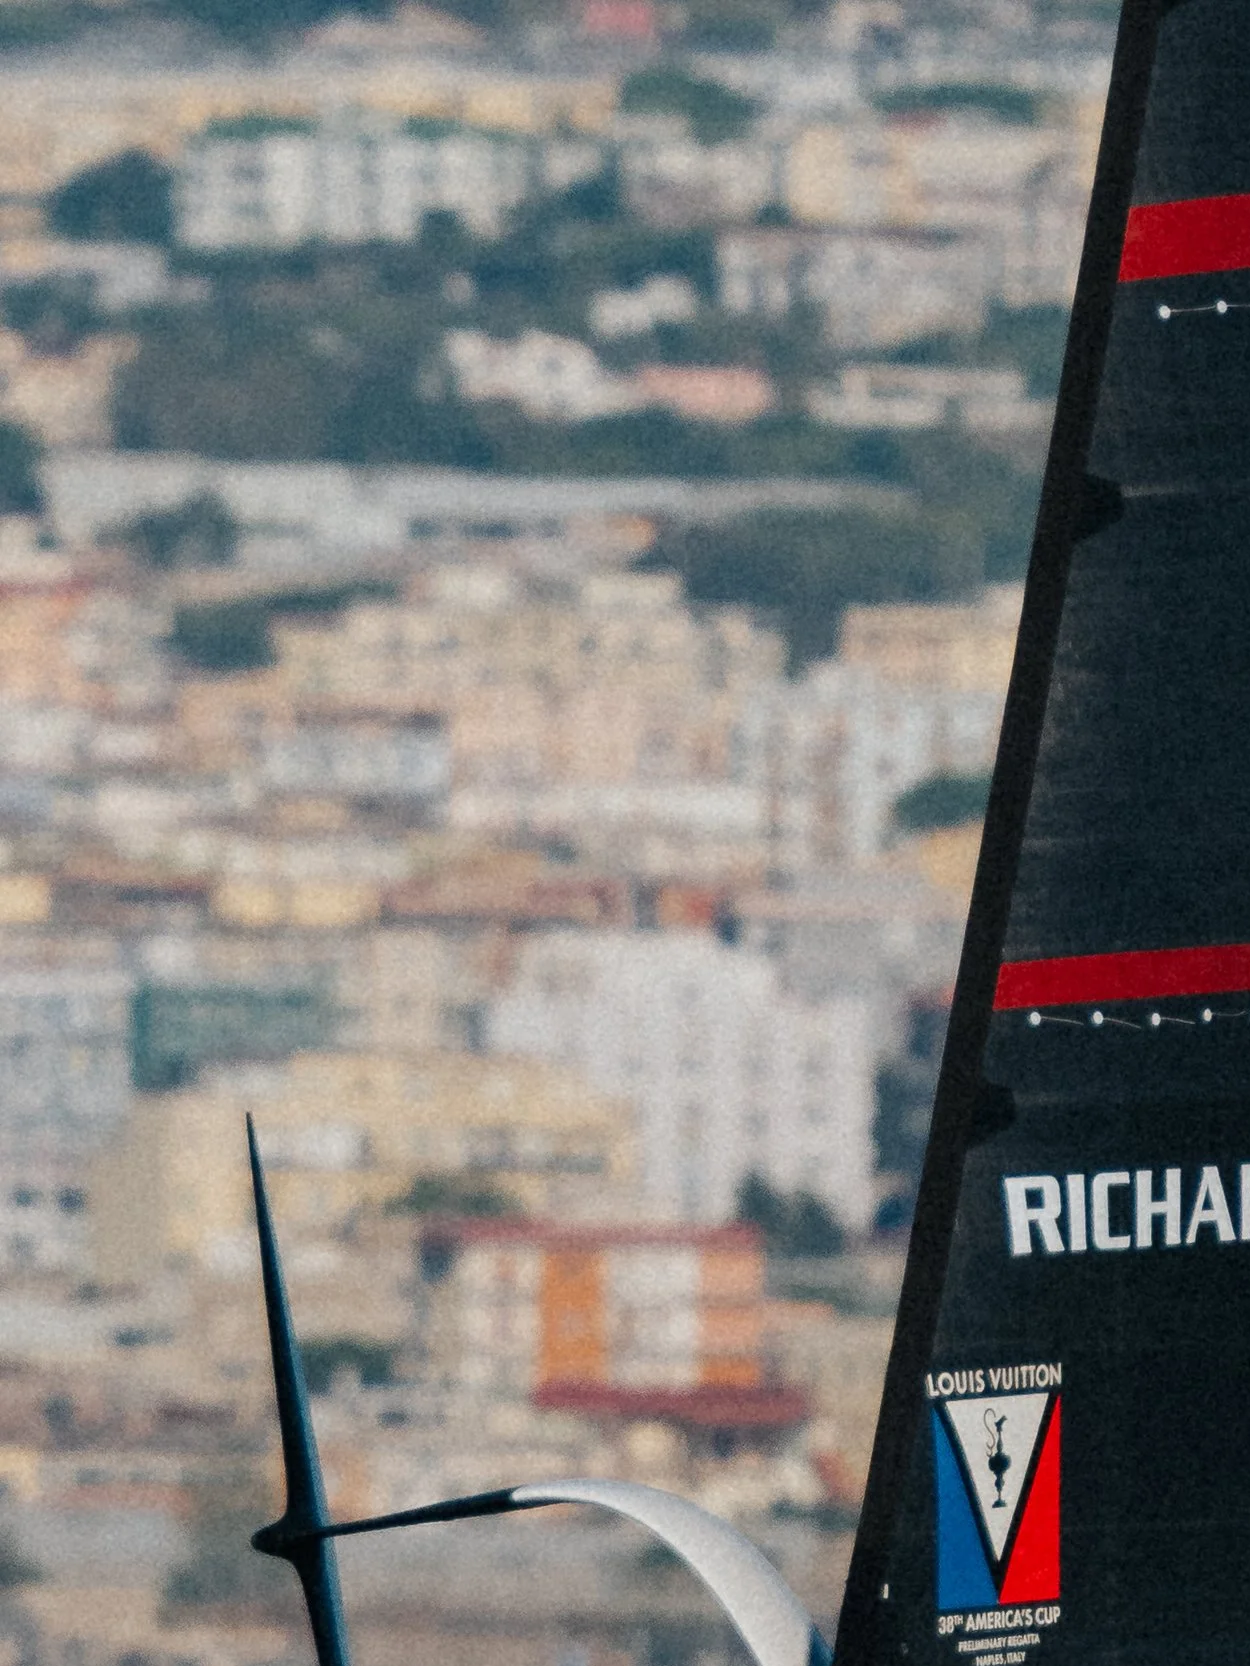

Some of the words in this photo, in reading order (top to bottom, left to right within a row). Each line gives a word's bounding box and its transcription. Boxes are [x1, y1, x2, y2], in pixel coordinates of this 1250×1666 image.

[926, 1371, 985, 1397] LOUIS
[988, 1362, 1062, 1390] VUITTON
[965, 1608, 1033, 1632] AMERICA'S
[1035, 1605, 1060, 1625] CUP
[958, 1636, 1007, 1652] PRELIMINARY
[1007, 1633, 1040, 1647] REGATTA
[1006, 1651, 1026, 1664] ITALY
